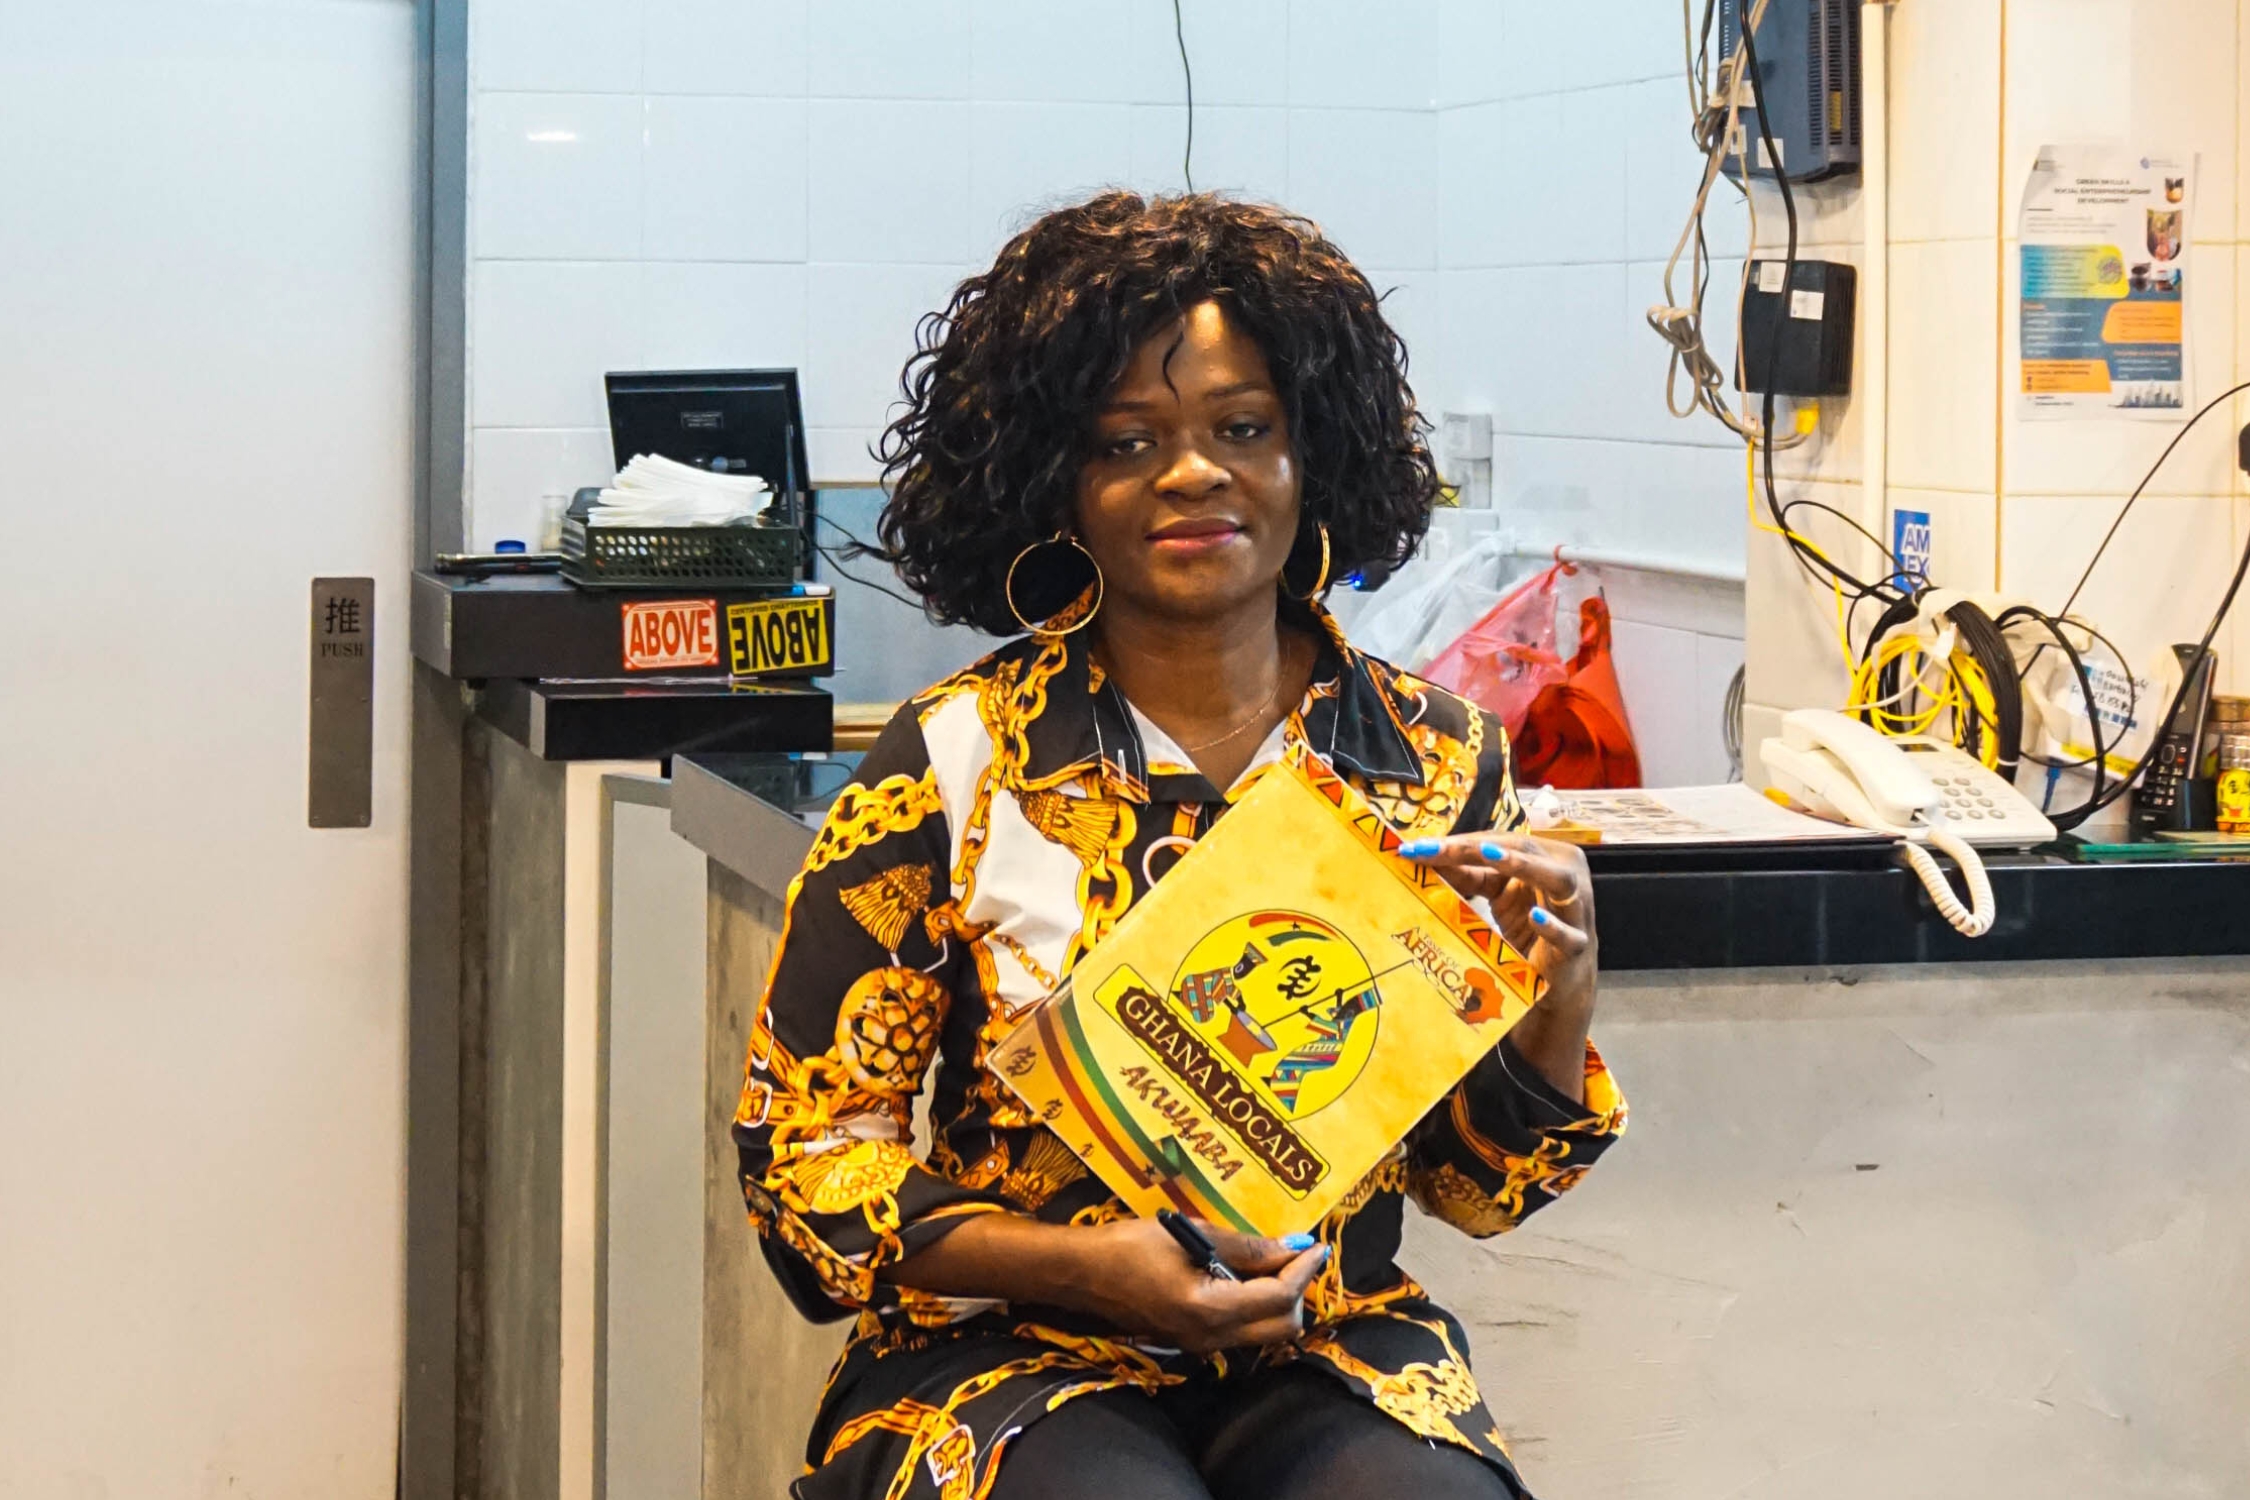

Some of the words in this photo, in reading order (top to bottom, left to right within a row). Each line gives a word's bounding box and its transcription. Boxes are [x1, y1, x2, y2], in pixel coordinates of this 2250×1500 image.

[1903, 526, 1930, 552] AM
[325, 598, 360, 633] 推
[629, 609, 713, 657] ABOVE
[730, 607, 820, 671] ABOVE
[321, 643, 363, 657] PUSH
[1391, 929, 1470, 1004] AFRICA
[1125, 995, 1213, 1089] GHANA
[1212, 1082, 1313, 1181] LOCALS
[1120, 1065, 1244, 1181] AKWAABA
